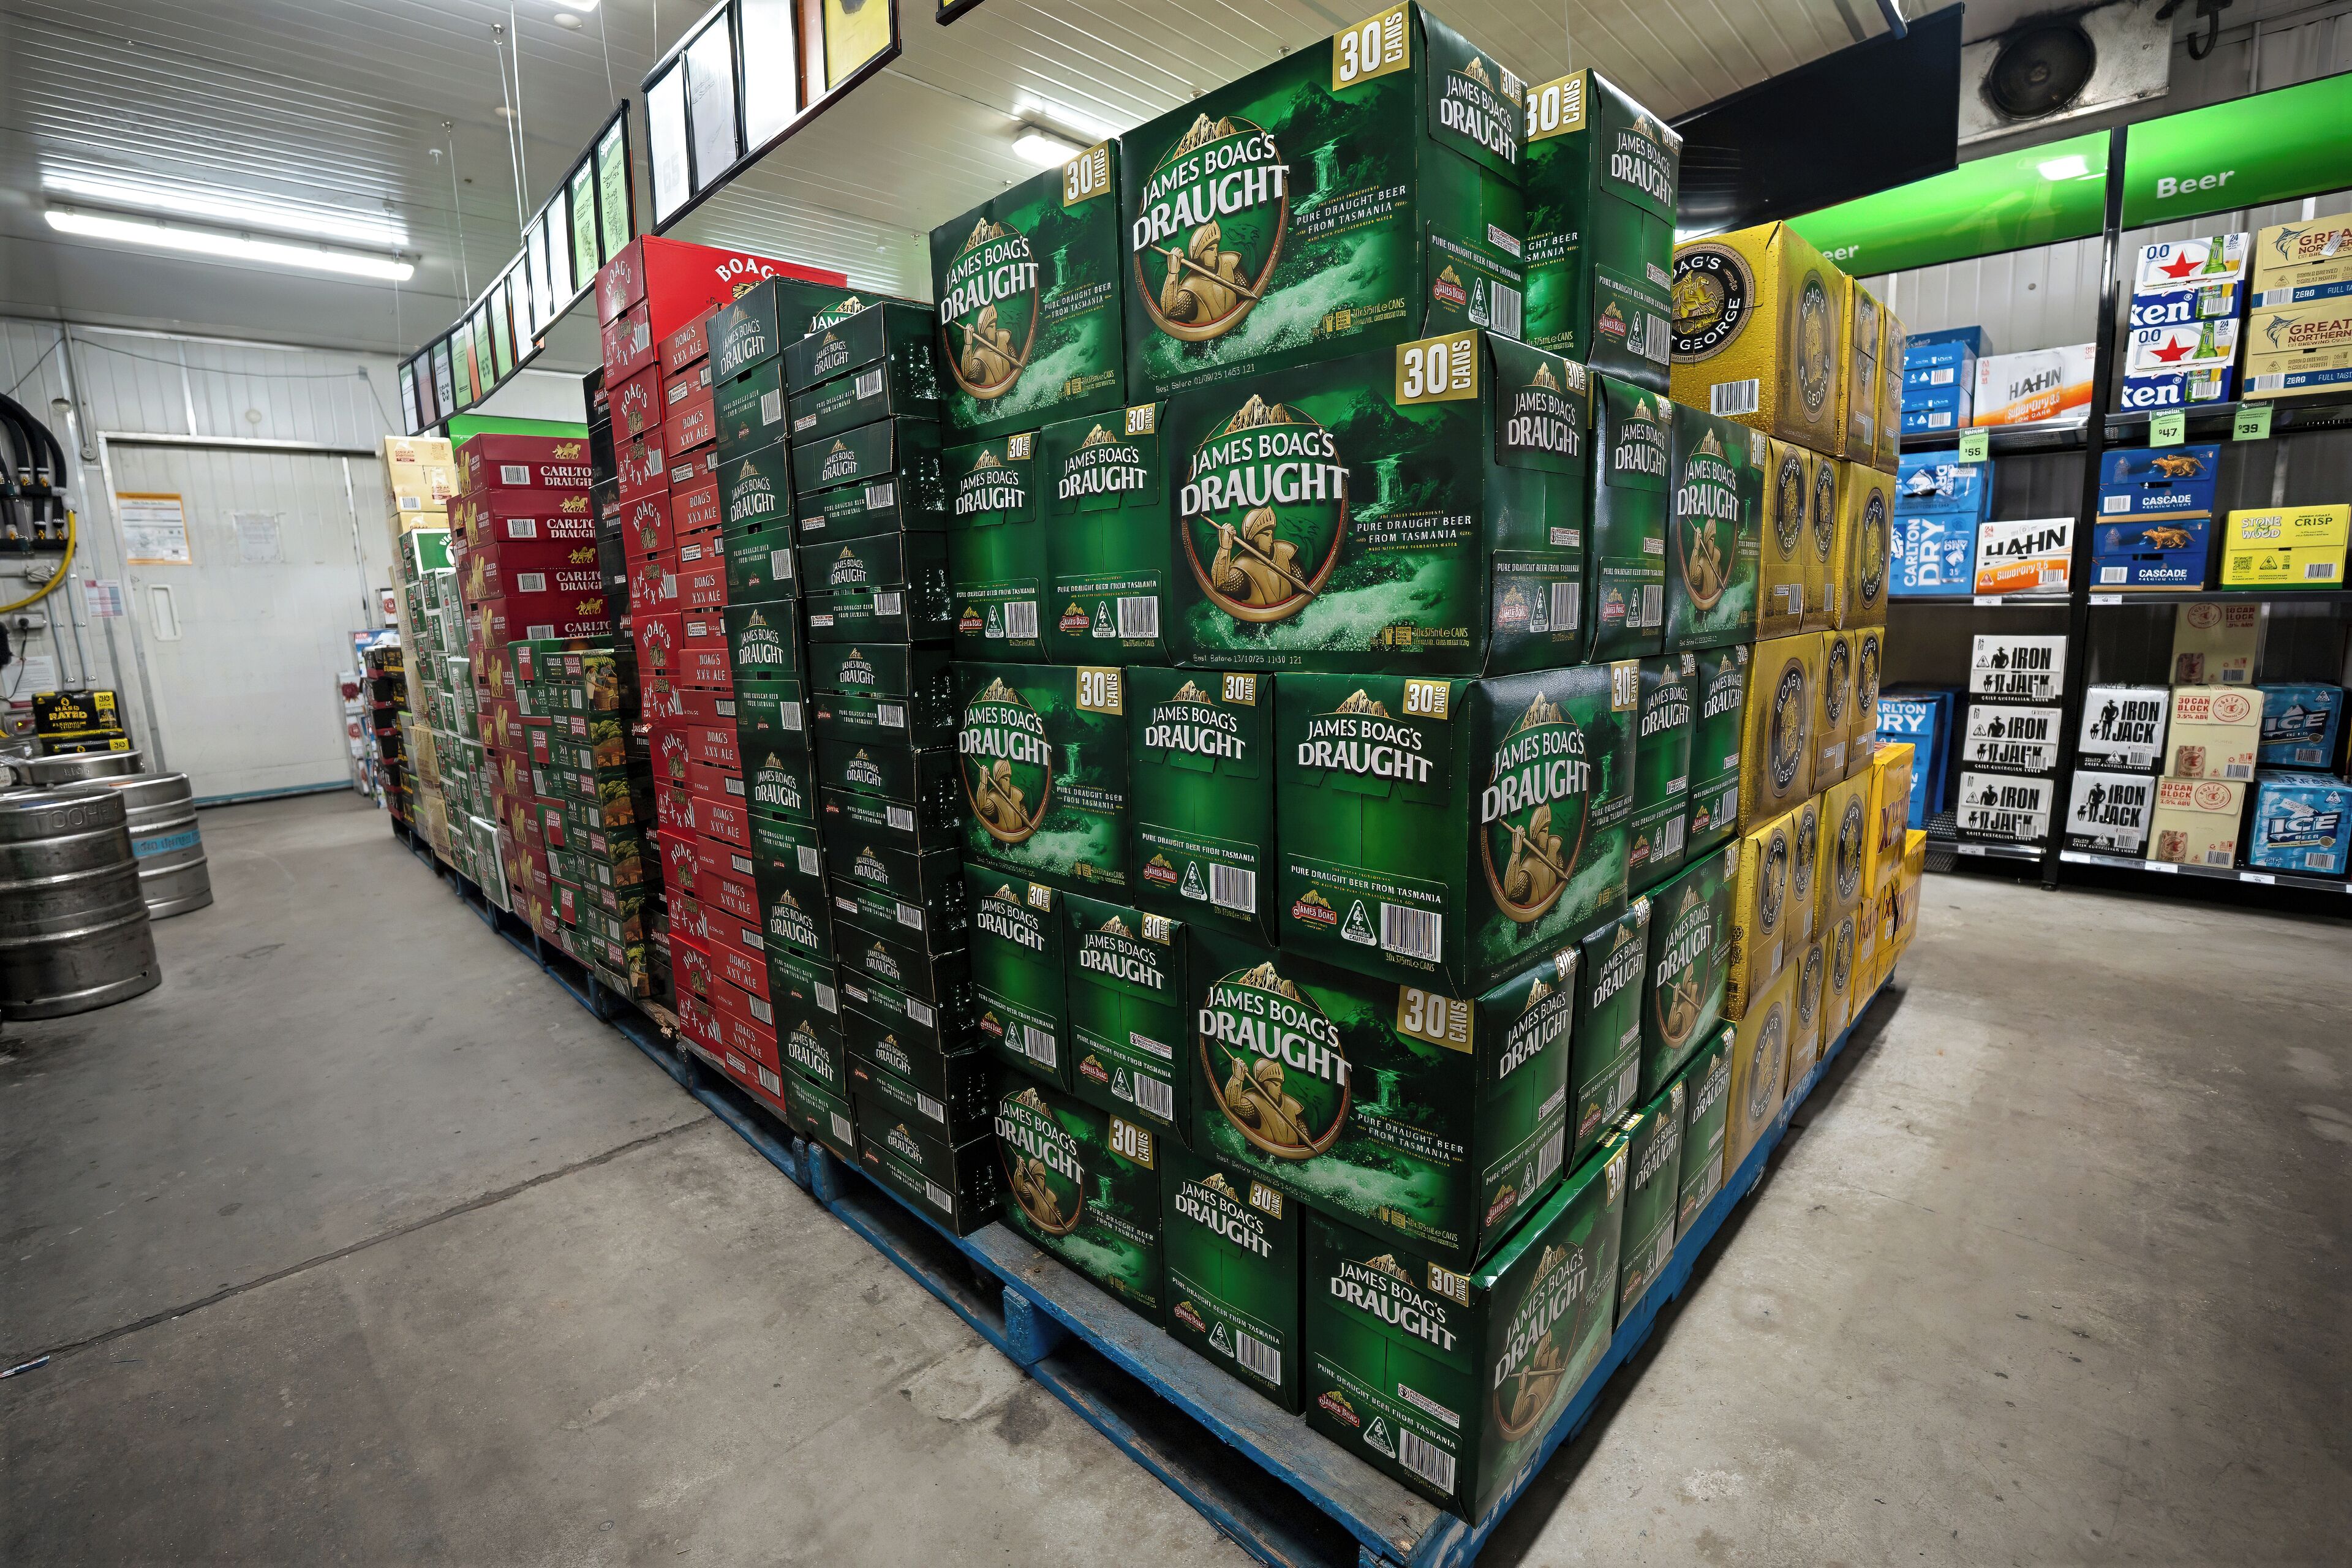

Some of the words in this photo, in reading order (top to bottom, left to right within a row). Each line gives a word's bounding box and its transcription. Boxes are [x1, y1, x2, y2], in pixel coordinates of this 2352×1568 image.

[1340, 21, 1381, 81] 30
[1385, 11, 1403, 64] CANS
[1440, 98, 1517, 165] DRAUGHT
[1142, 157, 1199, 214] JAMES
[1205, 133, 1276, 173] BOAG'S
[1611, 154, 1672, 208] DRAUGHT
[2157, 170, 2235, 198] Beer
[1133, 165, 1289, 252] DRAUGHT
[1297, 213, 1321, 225] PURE
[1325, 194, 1373, 217] DRAUGHT
[1378, 185, 1406, 201] BEER
[1308, 219, 1335, 234] FROM
[1339, 202, 1392, 224] TASMANIA
[2146, 244, 2170, 260] 0.0
[2299, 228, 2352, 246] GREA
[941, 263, 1039, 325] DRAUGHT
[1803, 287, 1825, 321] BOAG'S
[675, 326, 697, 349] BOAG'S
[740, 318, 761, 342] BOAG'S
[1680, 298, 1740, 350] GEORGE
[2138, 328, 2161, 344] 0.0
[2288, 331, 2352, 344] NORTHERN
[2290, 318, 2352, 334] GREAT
[673, 348, 687, 366] XXX
[689, 341, 701, 358] ALE
[720, 336, 765, 375] DRAUGHT
[815, 352, 849, 376] DRAUGHT
[1404, 343, 1449, 398] 30
[1452, 339, 1471, 390] CANS
[1807, 354, 1830, 407] GEORGE
[2010, 367, 2062, 401] HAHN
[621, 383, 647, 417] BOAG'S
[680, 429, 694, 446] XXX
[696, 424, 708, 439] ALE
[682, 410, 704, 430] BOAG'S
[1507, 418, 1580, 457] DRAUGHT
[1751, 432, 1762, 466] 30
[822, 461, 858, 481] DRAUGHT
[1064, 450, 1096, 477] JAMES
[1099, 447, 1139, 463] BOAG'S
[1192, 437, 1253, 481] JAMES
[1259, 429, 1334, 459] BOAG'S
[1615, 445, 1667, 477] DRAUGHT
[540, 466, 592, 477] CARLTO
[959, 473, 984, 495] JAMES
[987, 470, 1019, 485] BOAG'S
[1058, 466, 1147, 500] DRAUGHT
[689, 491, 710, 507] BOAG'S
[732, 486, 750, 503] JAMES
[751, 478, 771, 496] BOAG'S
[956, 487, 1026, 515] DRAUGHT
[1180, 463, 1350, 516] DRAUGHT
[1677, 484, 1739, 522] DRAUGHT
[2143, 495, 2192, 505] CASCADE
[546, 519, 595, 529] CARLTO
[688, 511, 701, 524] XXX
[701, 506, 717, 518] ALE
[730, 494, 775, 522] DRAUGHT
[1357, 522, 1382, 532] PURE
[1387, 518, 1437, 530] DRAUGHT
[1442, 515, 1471, 526] BEER
[2242, 516, 2282, 528] STONE
[2295, 518, 2332, 526] CRISP
[1368, 532, 1398, 543] FROM
[1400, 529, 1457, 541] TASMANIA
[1986, 525, 2066, 557] HAHN
[2242, 529, 2280, 539] WOOD
[1904, 518, 1920, 587] CARLTON
[1918, 518, 1945, 587] DRY
[831, 569, 867, 584] DRAUGHT
[2139, 569, 2187, 578] CASCADE
[739, 644, 783, 665] DRAUGHT
[2011, 647, 2051, 669] IRON
[840, 671, 875, 685] DRAUGHT
[1152, 706, 1188, 725] JAMES
[1191, 707, 1237, 733] BOAG'S
[1642, 704, 1691, 737] DRAUGHT
[1876, 703, 1926, 714] ARLTON
[2120, 700, 2161, 722] IRON
[2264, 712, 2327, 731] ICE
[1145, 725, 1246, 760] DRAUGHT
[1306, 719, 1357, 741] JAMES
[1361, 720, 1422, 751] BOAG'S
[2008, 717, 2048, 741] IRON
[2111, 722, 2157, 744] JACK
[959, 728, 1052, 767] DRAUGHT
[1298, 741, 1433, 783] DRAUGHT
[1491, 736, 1540, 785] JAMES
[1542, 729, 1585, 756] BOAG'S
[755, 785, 802, 810] DRAUGHT
[1481, 759, 1591, 824] DRAUGHT
[1999, 786, 2040, 810] IRON
[2108, 784, 2146, 806] IRON
[2099, 805, 2141, 827] JACK
[2267, 814, 2338, 837] ICE
[981, 899, 1006, 915] JAMES
[1007, 904, 1039, 930] BOAG'S
[977, 913, 1044, 952] DRAUGHT
[1085, 933, 1116, 950] JAMES
[1118, 941, 1156, 966] BOAG'S
[1080, 950, 1165, 990] DRAUGHT
[1208, 986, 1265, 1016] JAMES
[1269, 1000, 1339, 1048] BOAG'S
[1404, 987, 1447, 1039] 30
[1449, 999, 1467, 1043] CANS
[1199, 1008, 1352, 1087] DRAUGHT
[1499, 1009, 1569, 1080] DRAUGHT
[1357, 1113, 1382, 1128] PURE
[1385, 1122, 1432, 1146] DRAUGHT
[1436, 1138, 1464, 1154] BEER
[1368, 1126, 1395, 1143] FROM
[1398, 1137, 1450, 1161] TASMANIA
[994, 1116, 1084, 1185] DRAUGHT
[1175, 1194, 1272, 1258] DRAUGHT
[1339, 1262, 1387, 1292] JAMES
[1391, 1280, 1447, 1323] BOAG'S
[1331, 1277, 1457, 1352] DRAUGHT
[1494, 1267, 1588, 1390] DRAUGHT
